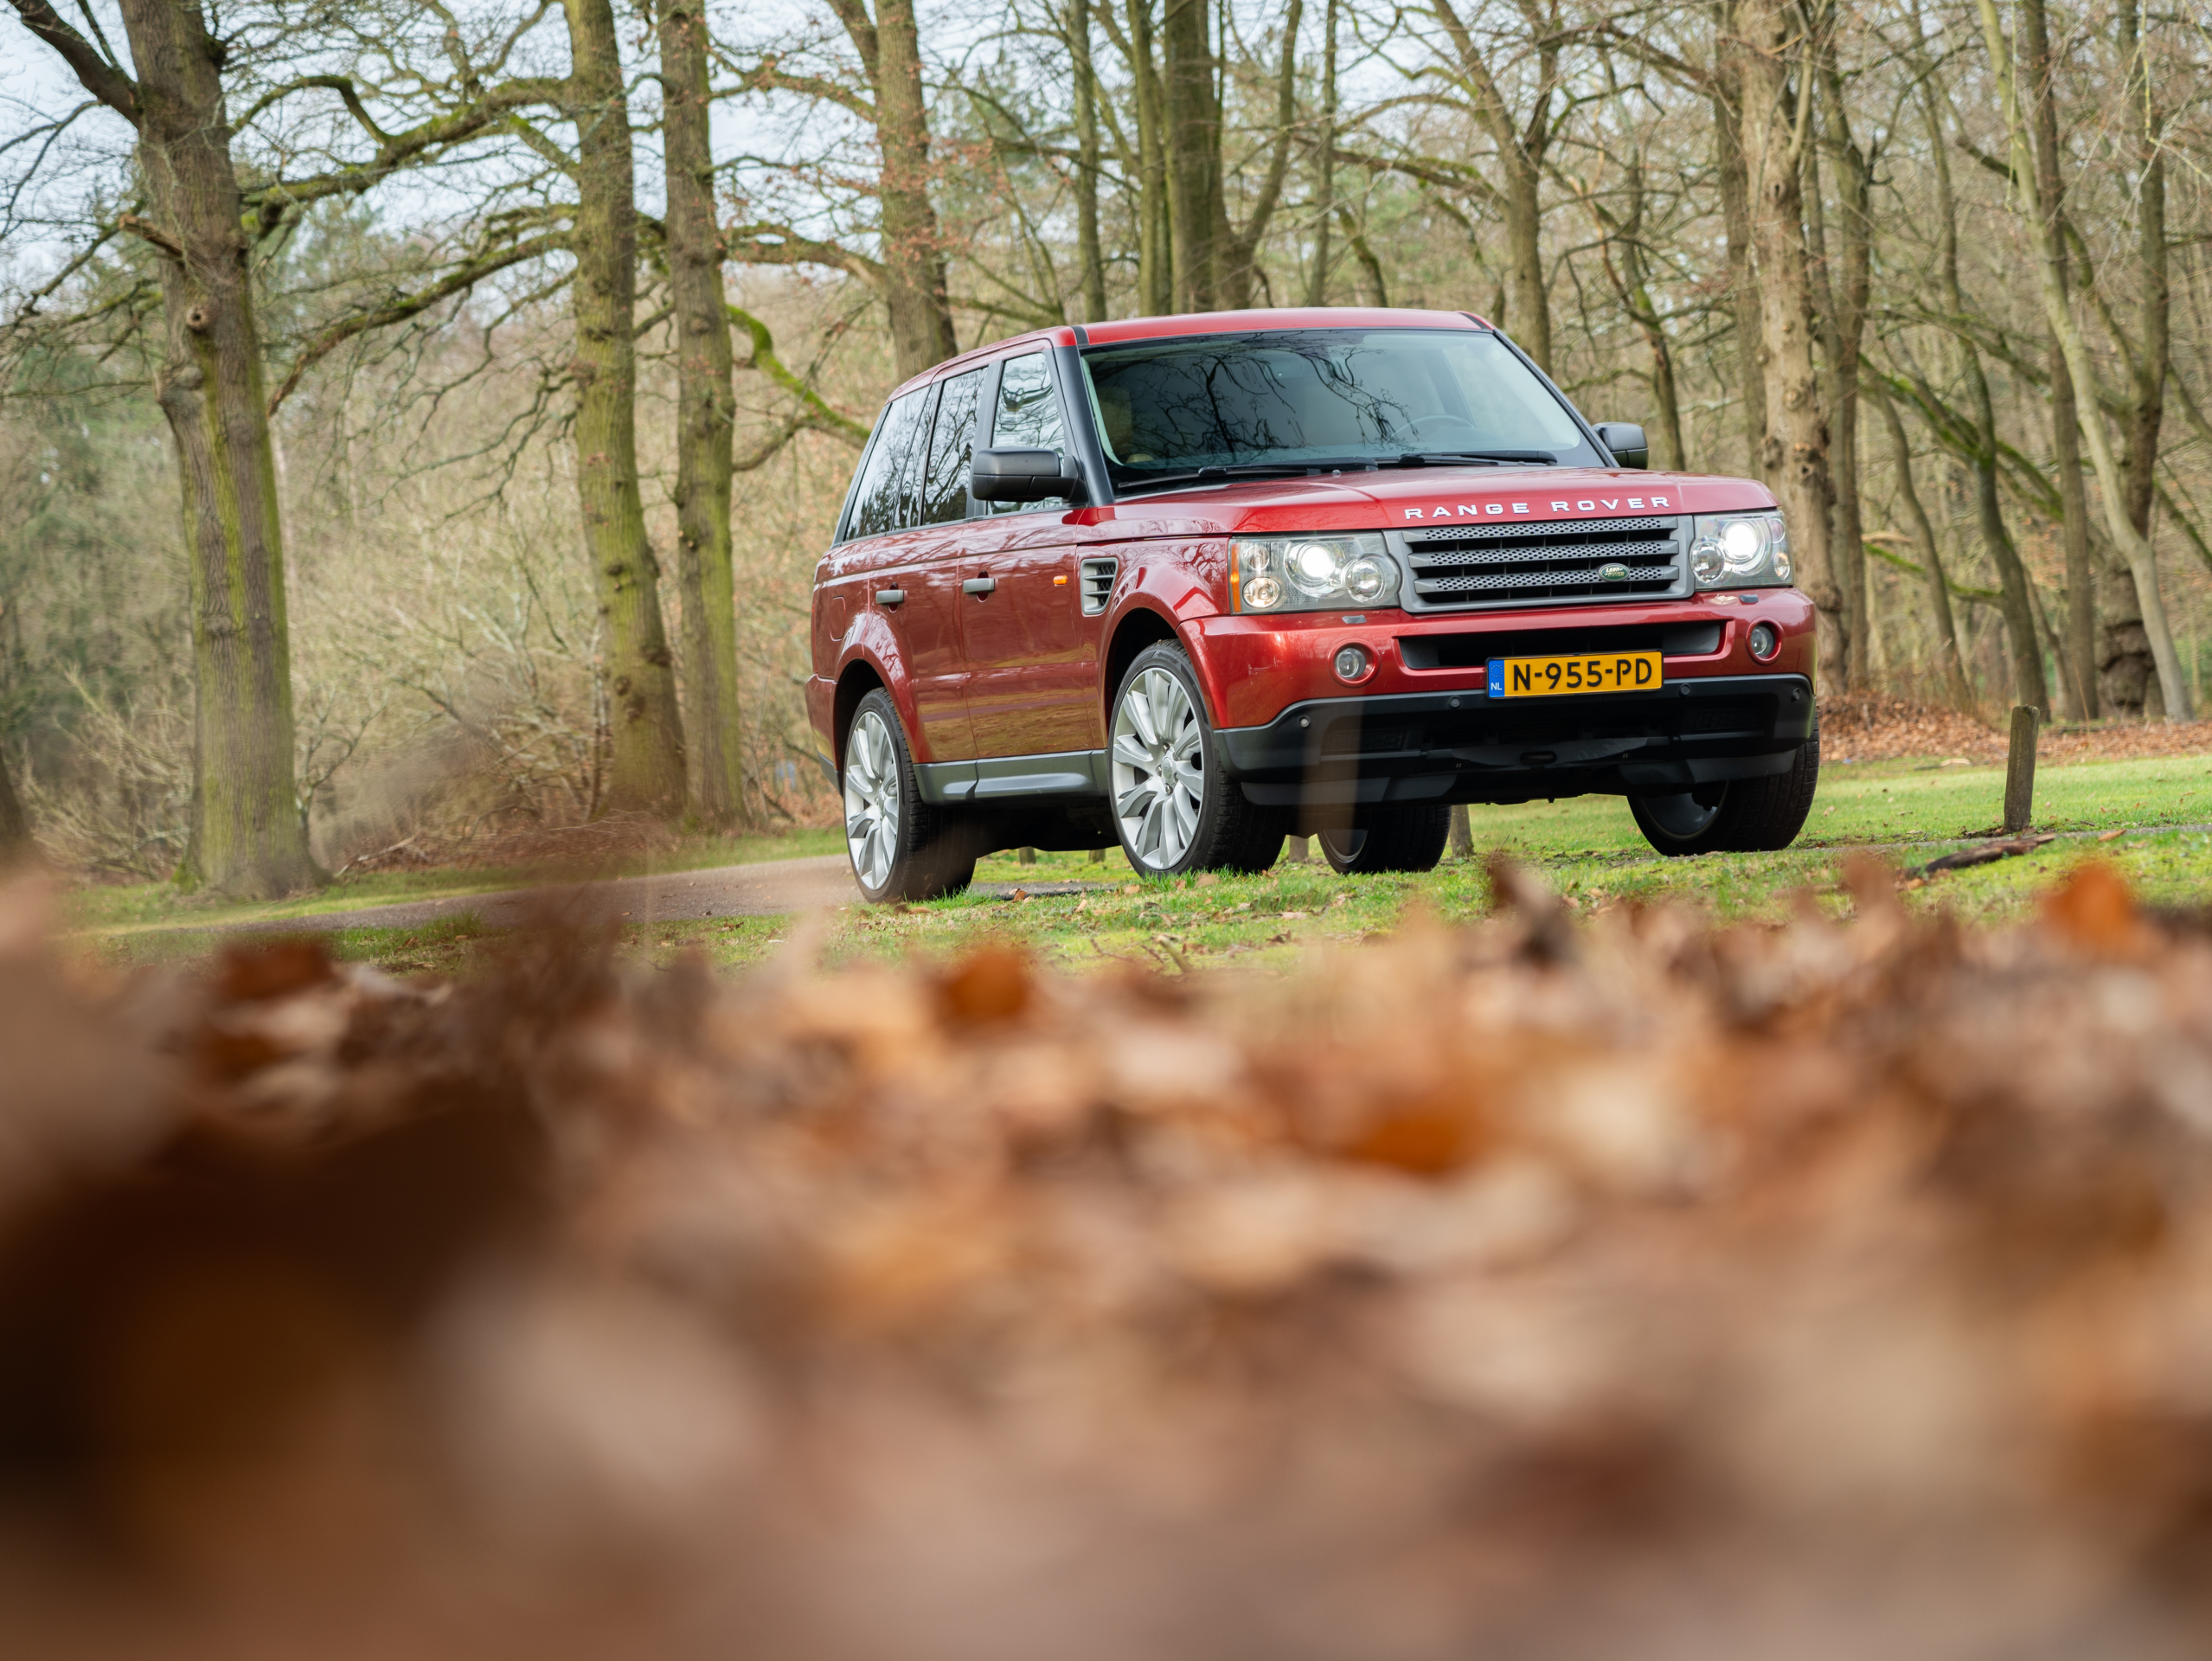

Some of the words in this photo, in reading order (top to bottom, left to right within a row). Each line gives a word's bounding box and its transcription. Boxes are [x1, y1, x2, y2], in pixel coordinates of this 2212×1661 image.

[1404, 503, 1529, 520] RANGE
[1550, 497, 1670, 512] ROVER
[1513, 658, 1652, 690] N-955-PD
[1491, 682, 1503, 690] NL
